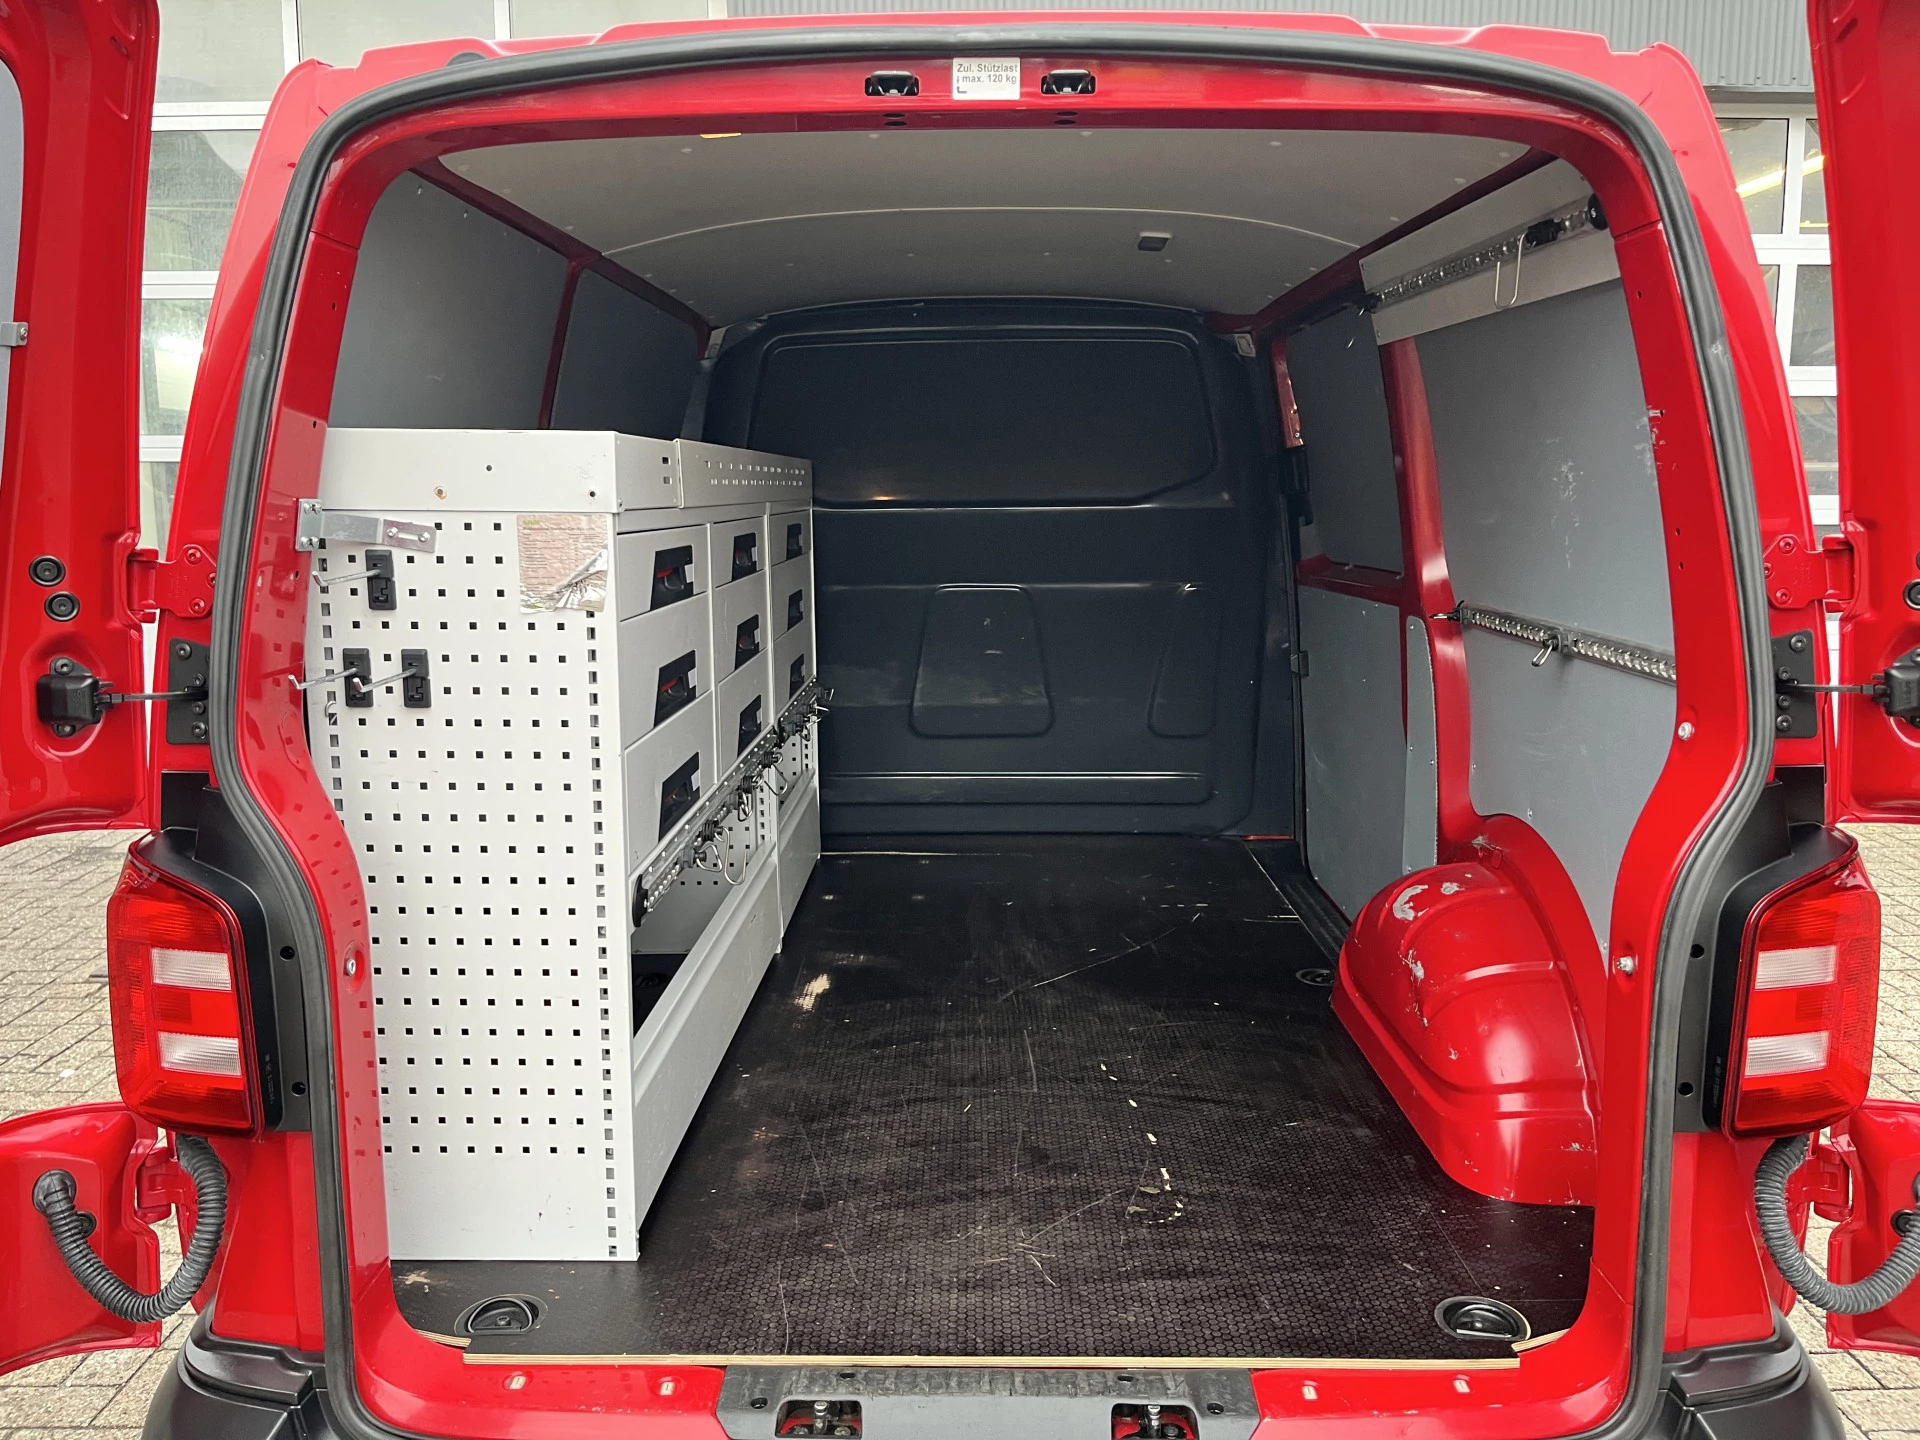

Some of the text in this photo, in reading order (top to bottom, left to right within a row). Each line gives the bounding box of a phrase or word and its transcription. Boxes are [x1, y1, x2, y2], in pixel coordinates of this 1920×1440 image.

[957, 63, 1018, 73] Zul. Stützlast
[962, 73, 1017, 84] max. 120 kg
